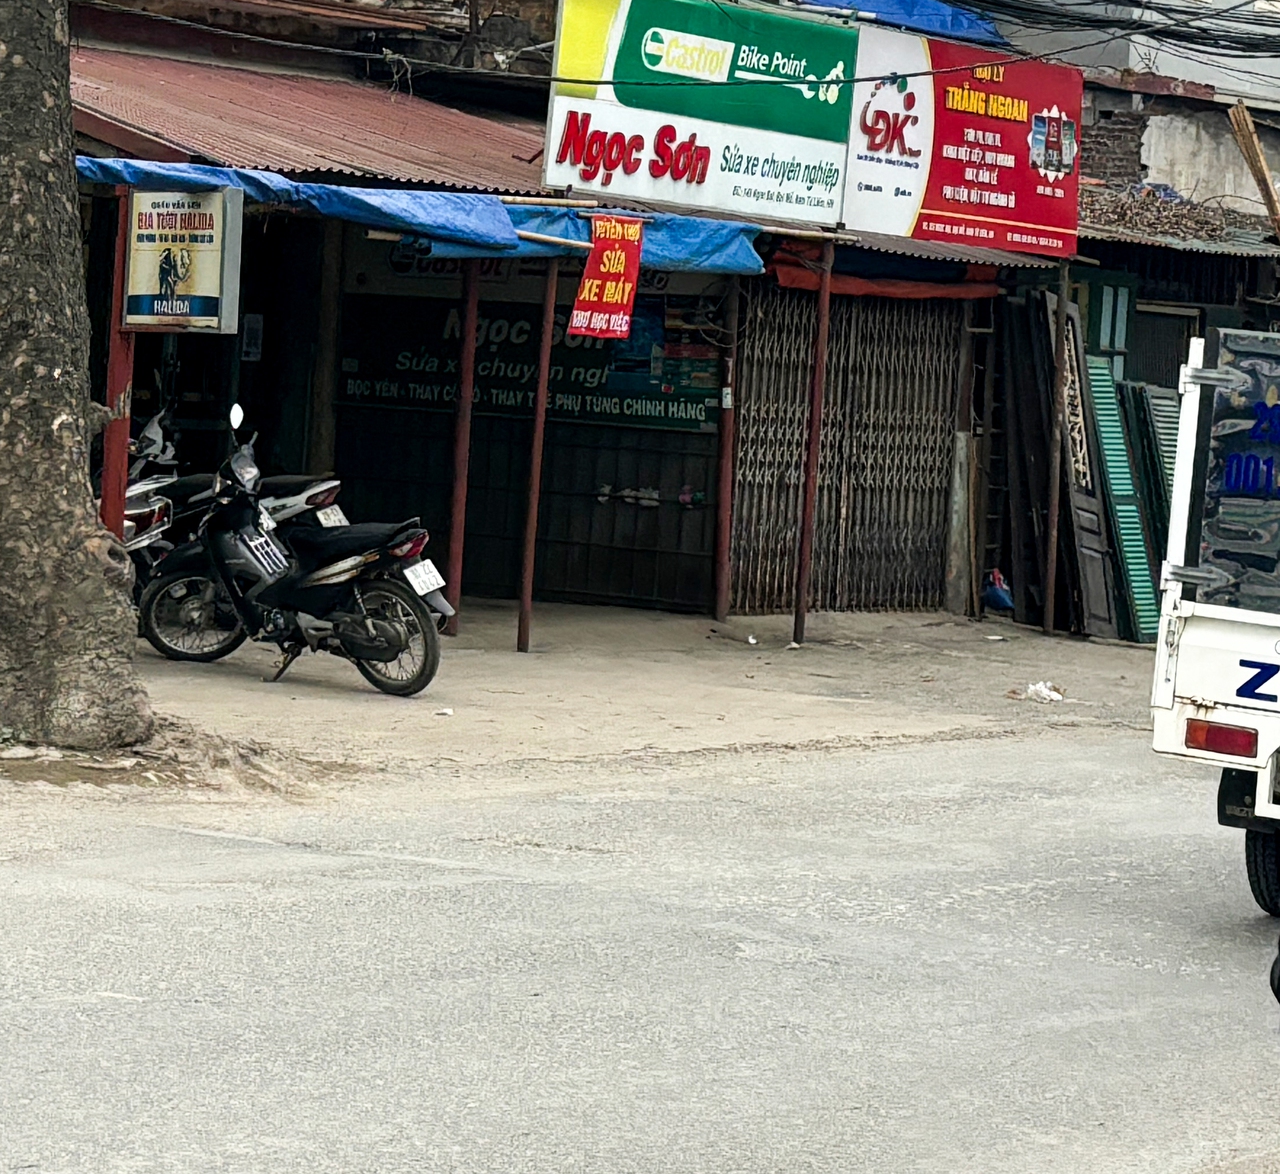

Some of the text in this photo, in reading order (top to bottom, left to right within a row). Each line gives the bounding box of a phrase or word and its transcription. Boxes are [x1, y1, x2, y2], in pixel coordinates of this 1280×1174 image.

[665, 37, 807, 77] Castrol Bike Point
[556, 110, 711, 186] Ngọc Sơn
[743, 155, 759, 175] xe
[761, 152, 801, 187] chuyên
[154, 299, 190, 314] HALIDA
[580, 279, 602, 301] XE
[603, 277, 633, 304] MÁY
[408, 383, 440, 401] THAY
[491, 388, 524, 407] THAY
[624, 395, 665, 418] CHÍNH
